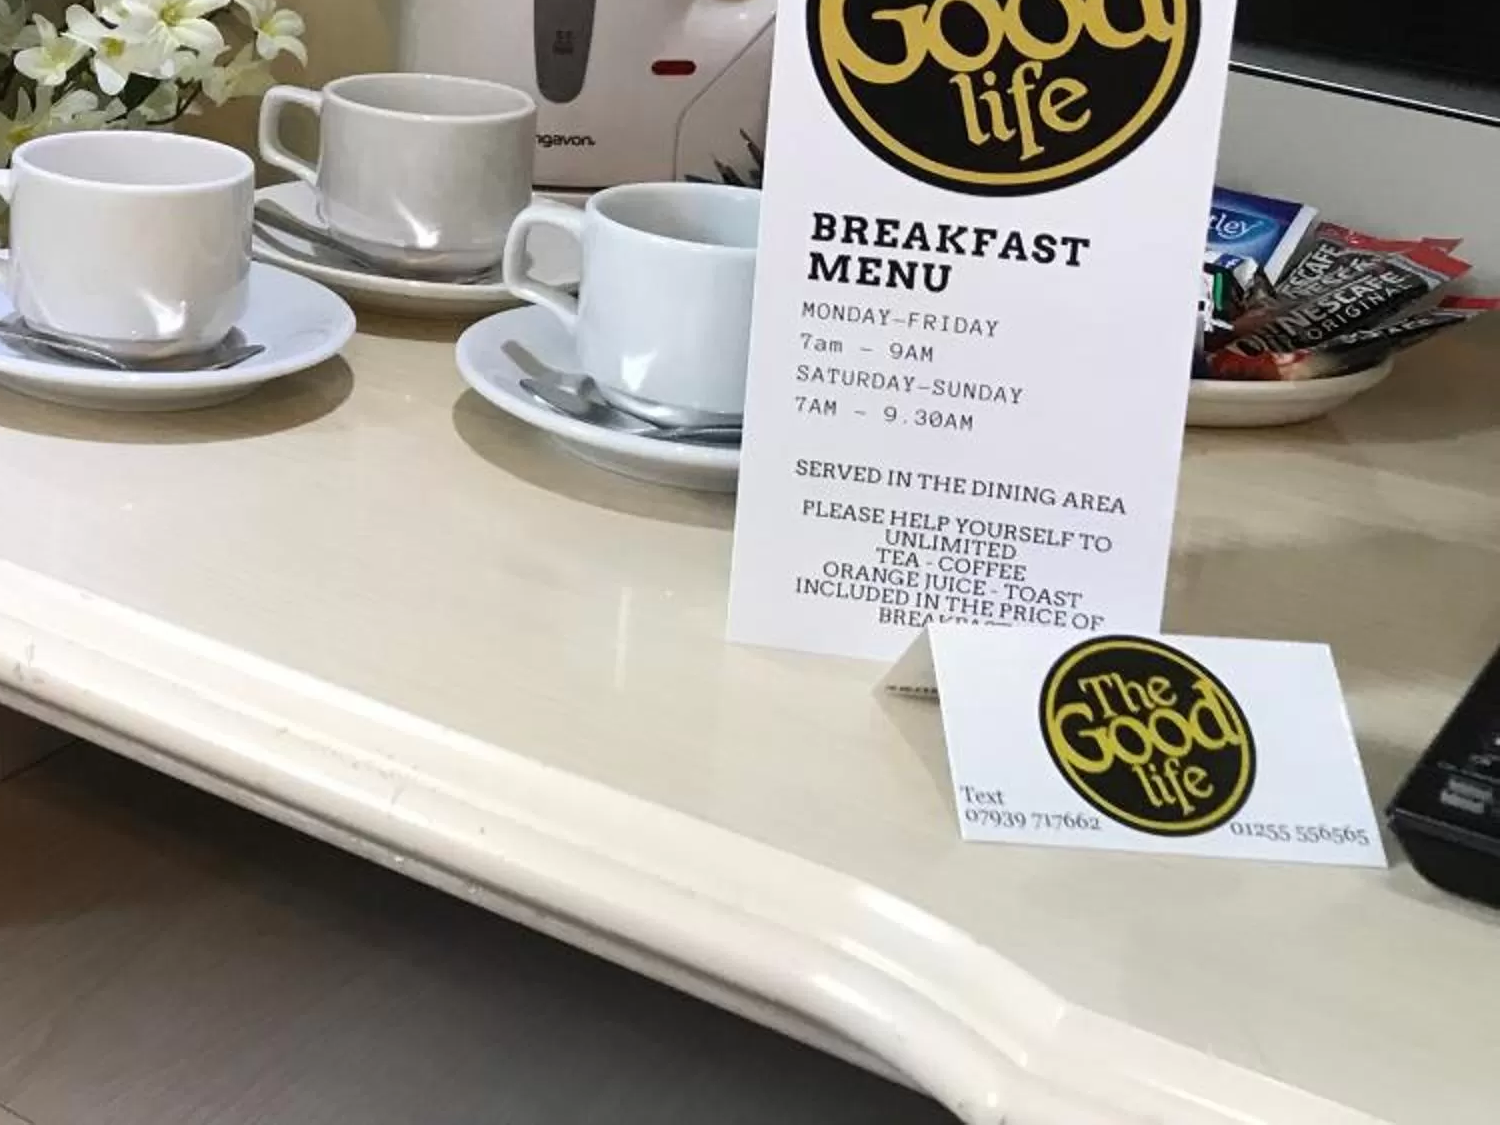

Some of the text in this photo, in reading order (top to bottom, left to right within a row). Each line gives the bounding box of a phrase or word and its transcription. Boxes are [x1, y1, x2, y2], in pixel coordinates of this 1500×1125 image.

[950, 61, 1092, 161] life
[811, 212, 1091, 267] BREAKFAST
[807, 252, 952, 293] MENU
[1307, 283, 1412, 340] ORIGINAL
[800, 333, 843, 354] 7am
[889, 342, 934, 362] 9AM
[795, 396, 838, 416] 7AM
[883, 407, 974, 431] 9.30AM
[795, 459, 1127, 514] SERVED IN THE DINING AREA
[803, 499, 1113, 553] PLEASE HELP YOURSELF TO
[885, 528, 1018, 561] UNLIMITED
[823, 561, 920, 589] ORANGE
[924, 574, 987, 597] JUICE
[1004, 584, 1083, 609] TOAST
[876, 546, 921, 568] TEA
[938, 556, 1027, 582] COFFEE
[796, 577, 1105, 633] INCLUDED IN THE PRICE OF
[1080, 672, 1177, 719] The
[1050, 678, 1242, 773] Good
[960, 785, 1005, 806] Text
[1132, 763, 1215, 816] life
[965, 808, 1101, 832] 07939 717662
[1229, 822, 1371, 847] 01255 556565
